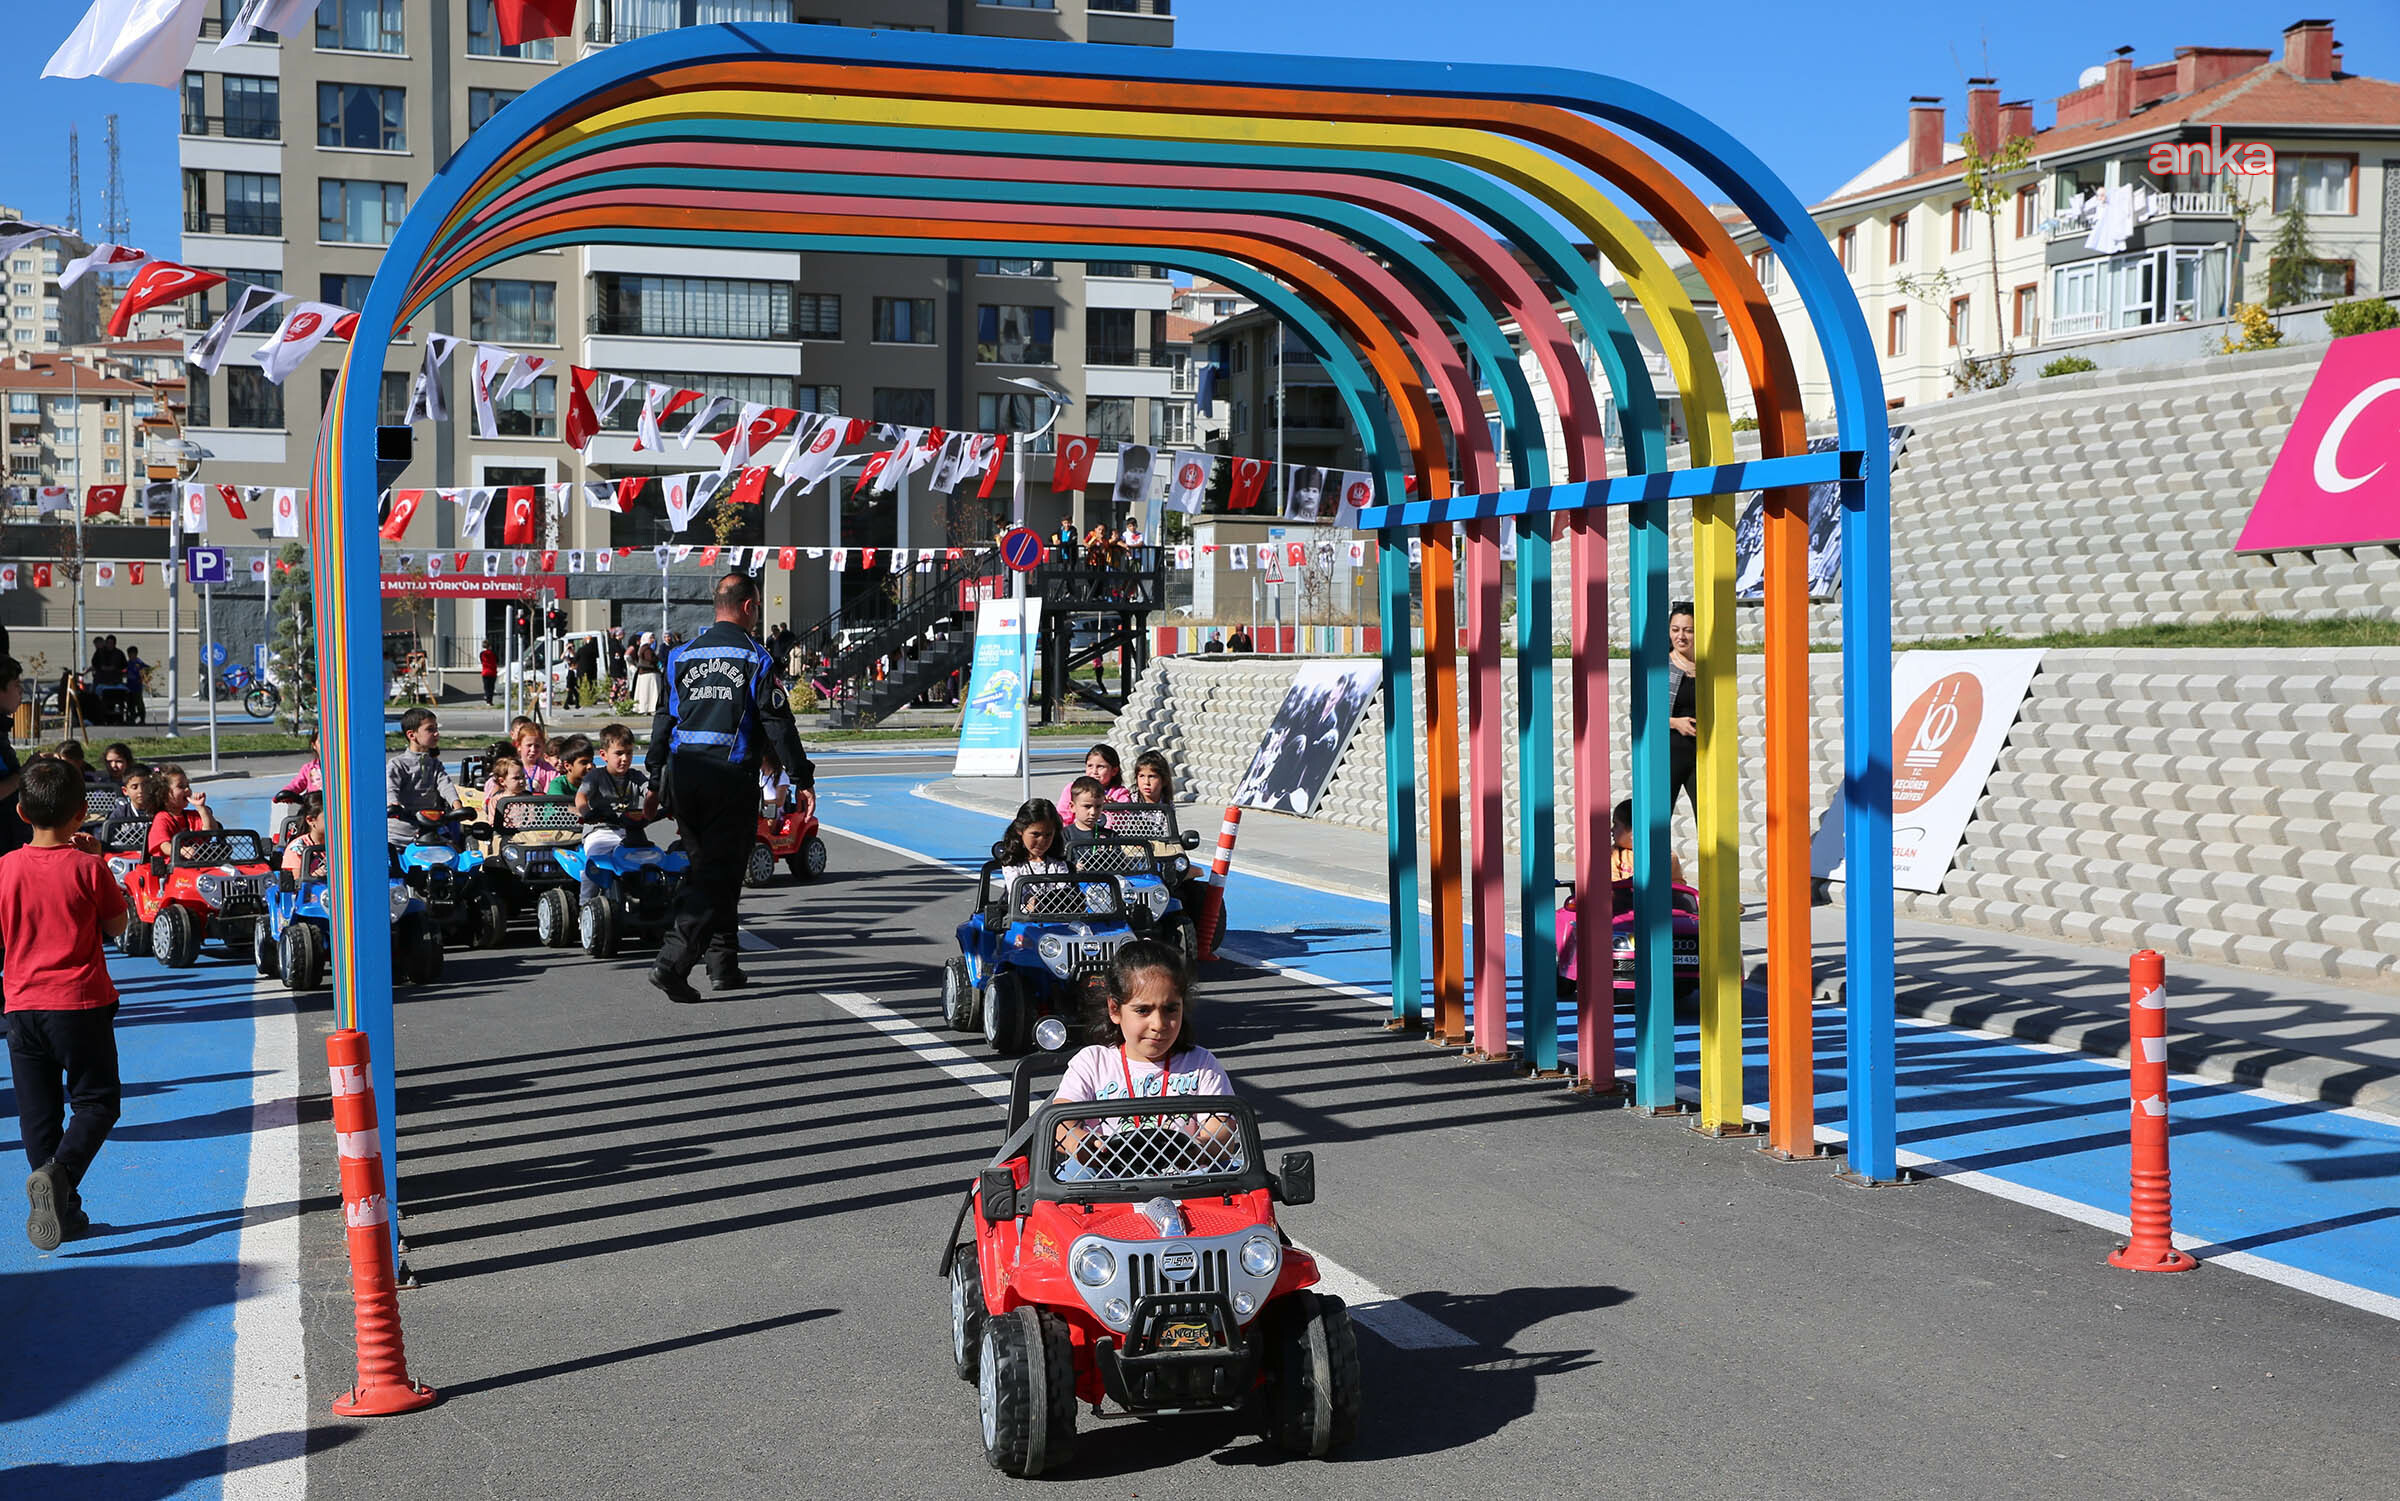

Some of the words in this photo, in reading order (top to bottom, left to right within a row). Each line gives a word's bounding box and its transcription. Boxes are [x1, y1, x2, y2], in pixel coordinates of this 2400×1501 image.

[196, 552, 217, 578] P
[388, 581, 427, 591] MUTLU
[681, 659, 745, 688] KEÇİÖREN
[690, 686, 732, 700] ZABITA
[1893, 846, 1917, 857] RSLAN
[1162, 1328, 1209, 1338] ANGER
